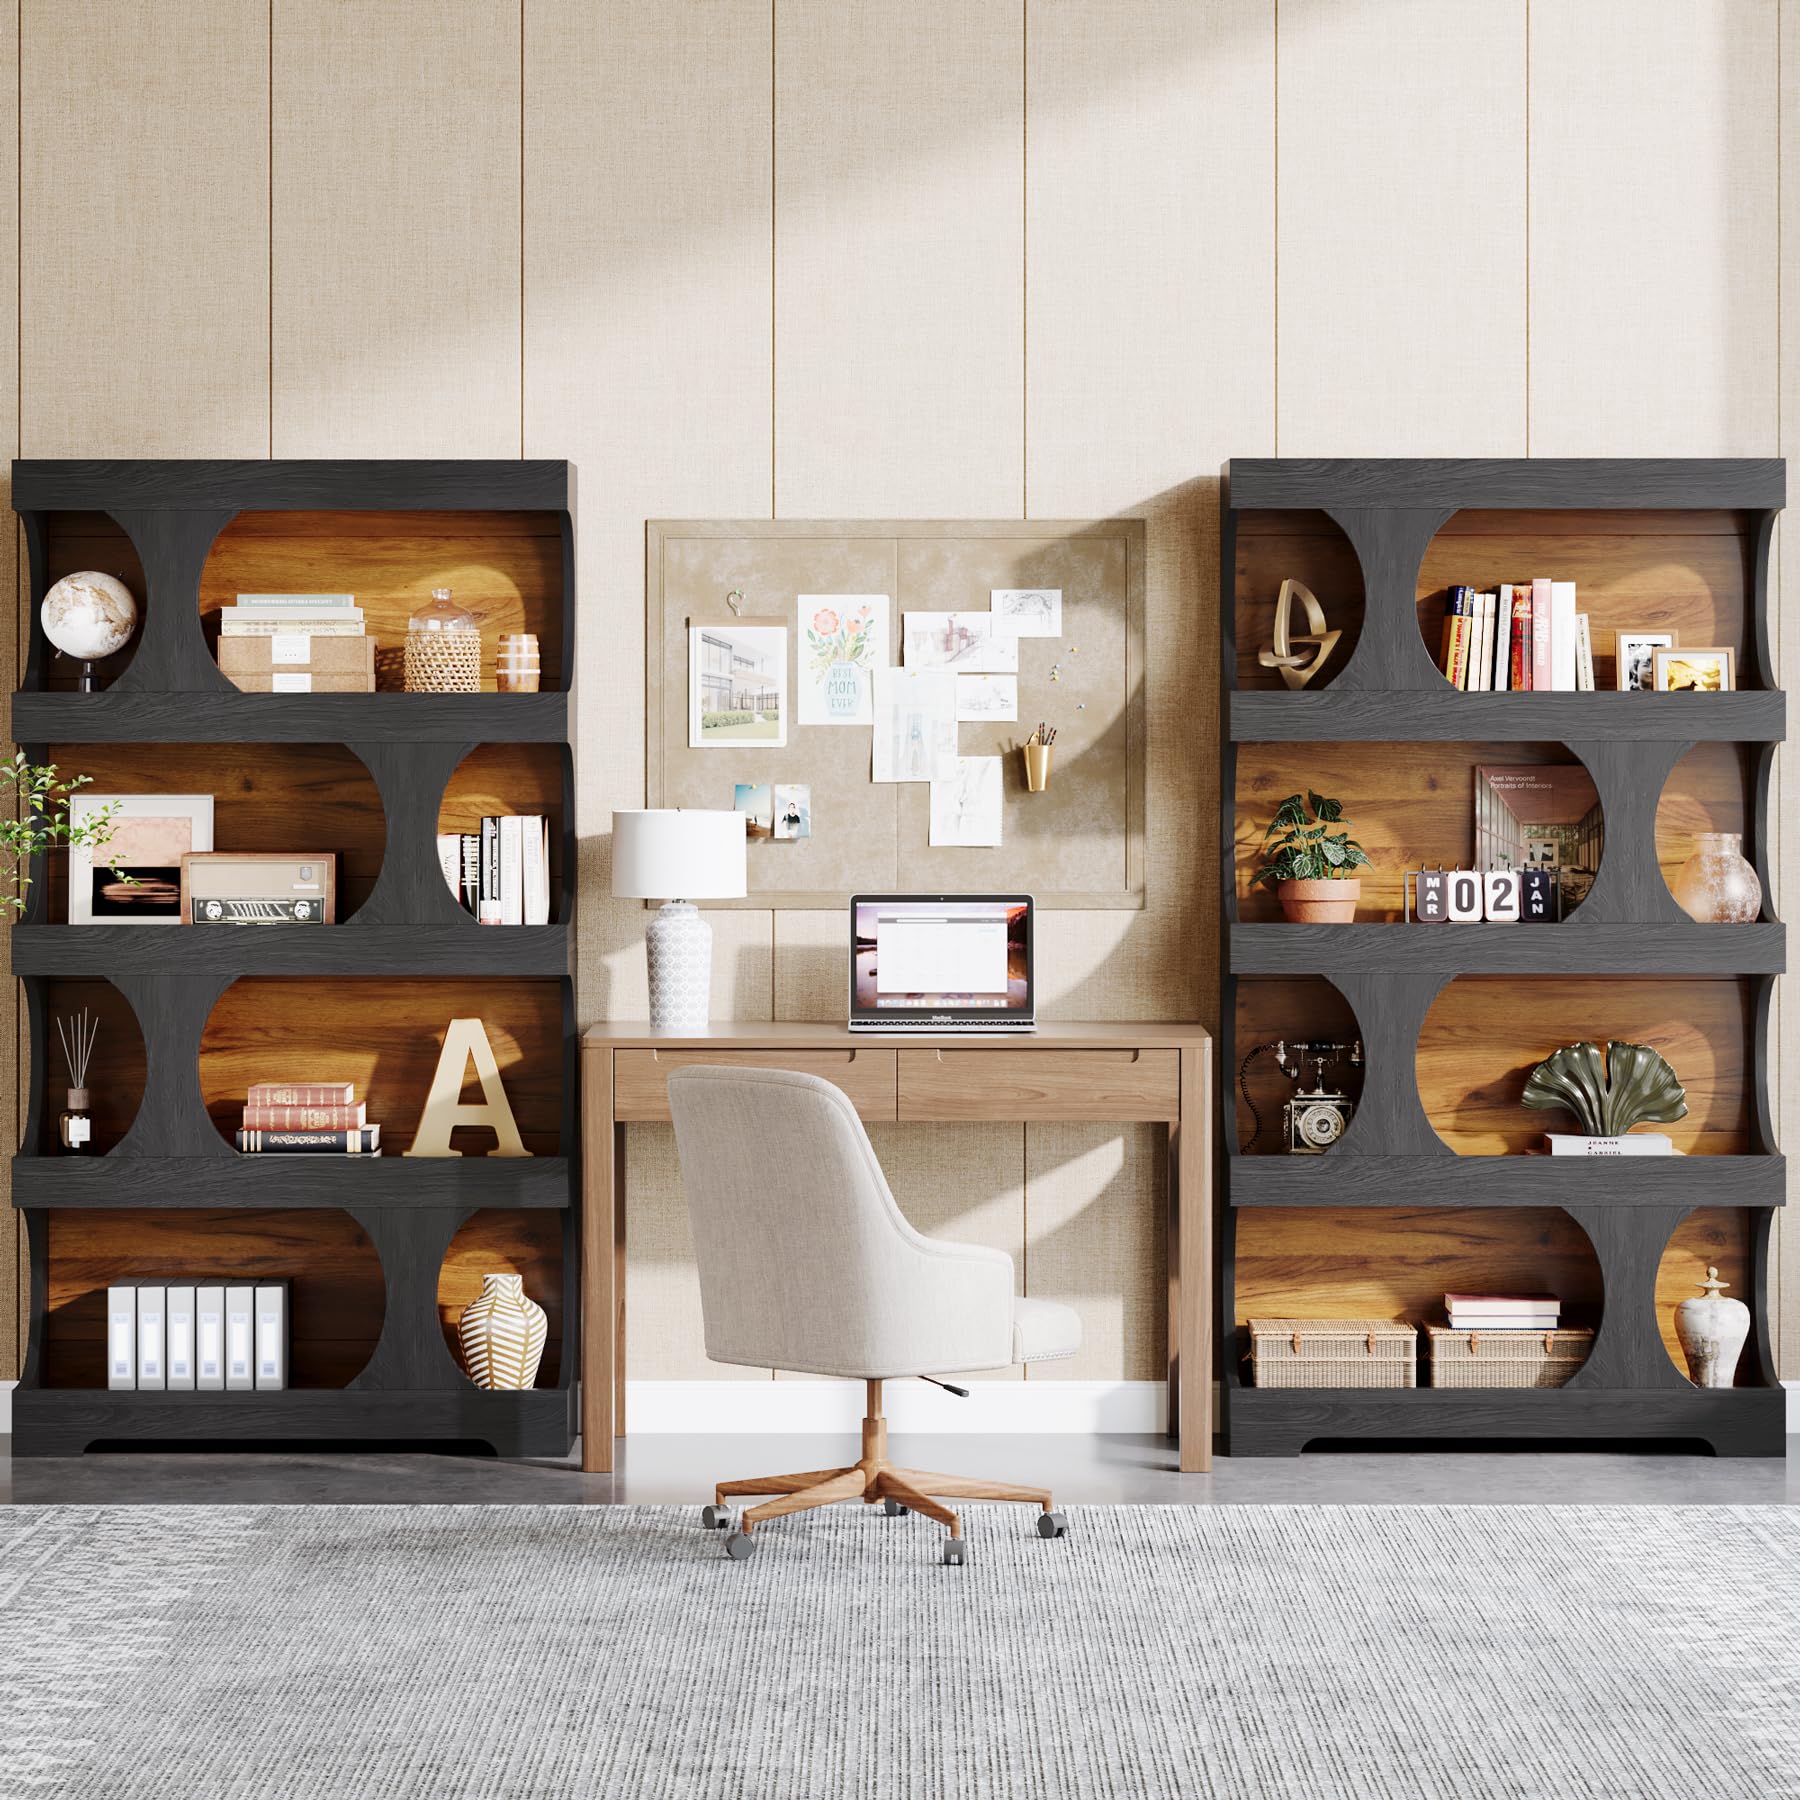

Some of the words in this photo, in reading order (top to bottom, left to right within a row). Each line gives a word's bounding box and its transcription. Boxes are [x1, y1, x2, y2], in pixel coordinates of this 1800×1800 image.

[828, 681, 856, 694] MOM
[831, 698, 853, 709] EVER
[1425, 877, 1440, 914] MAR
[1530, 877, 1544, 914] JAN
[402, 1018, 535, 1158] A
